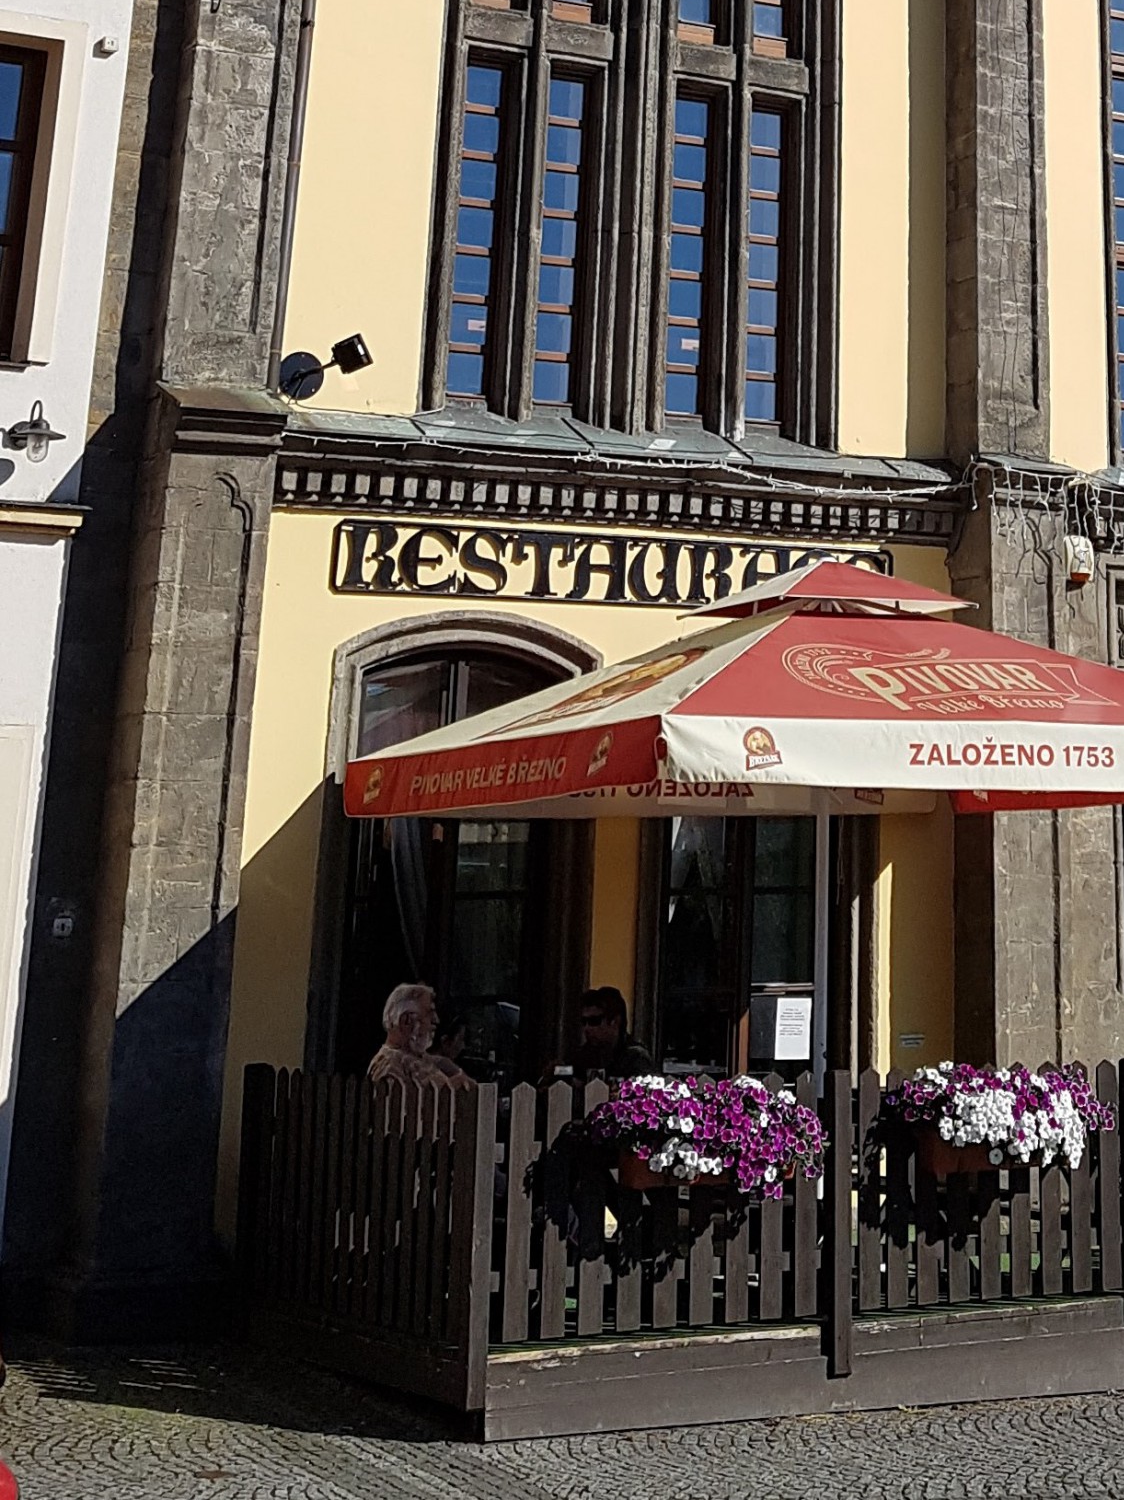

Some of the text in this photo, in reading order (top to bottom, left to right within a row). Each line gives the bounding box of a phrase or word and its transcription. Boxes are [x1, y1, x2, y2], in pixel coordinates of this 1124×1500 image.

[341, 522, 886, 606] RESTAURA
[847, 663, 1056, 712] PIVOVAR
[916, 695, 985, 715] Velké
[908, 735, 1115, 768] ZALOŽENO 1753
[409, 769, 464, 797] PIVOVAR
[466, 757, 507, 789] VELKÉ
[507, 754, 567, 785] BŘEZNO
